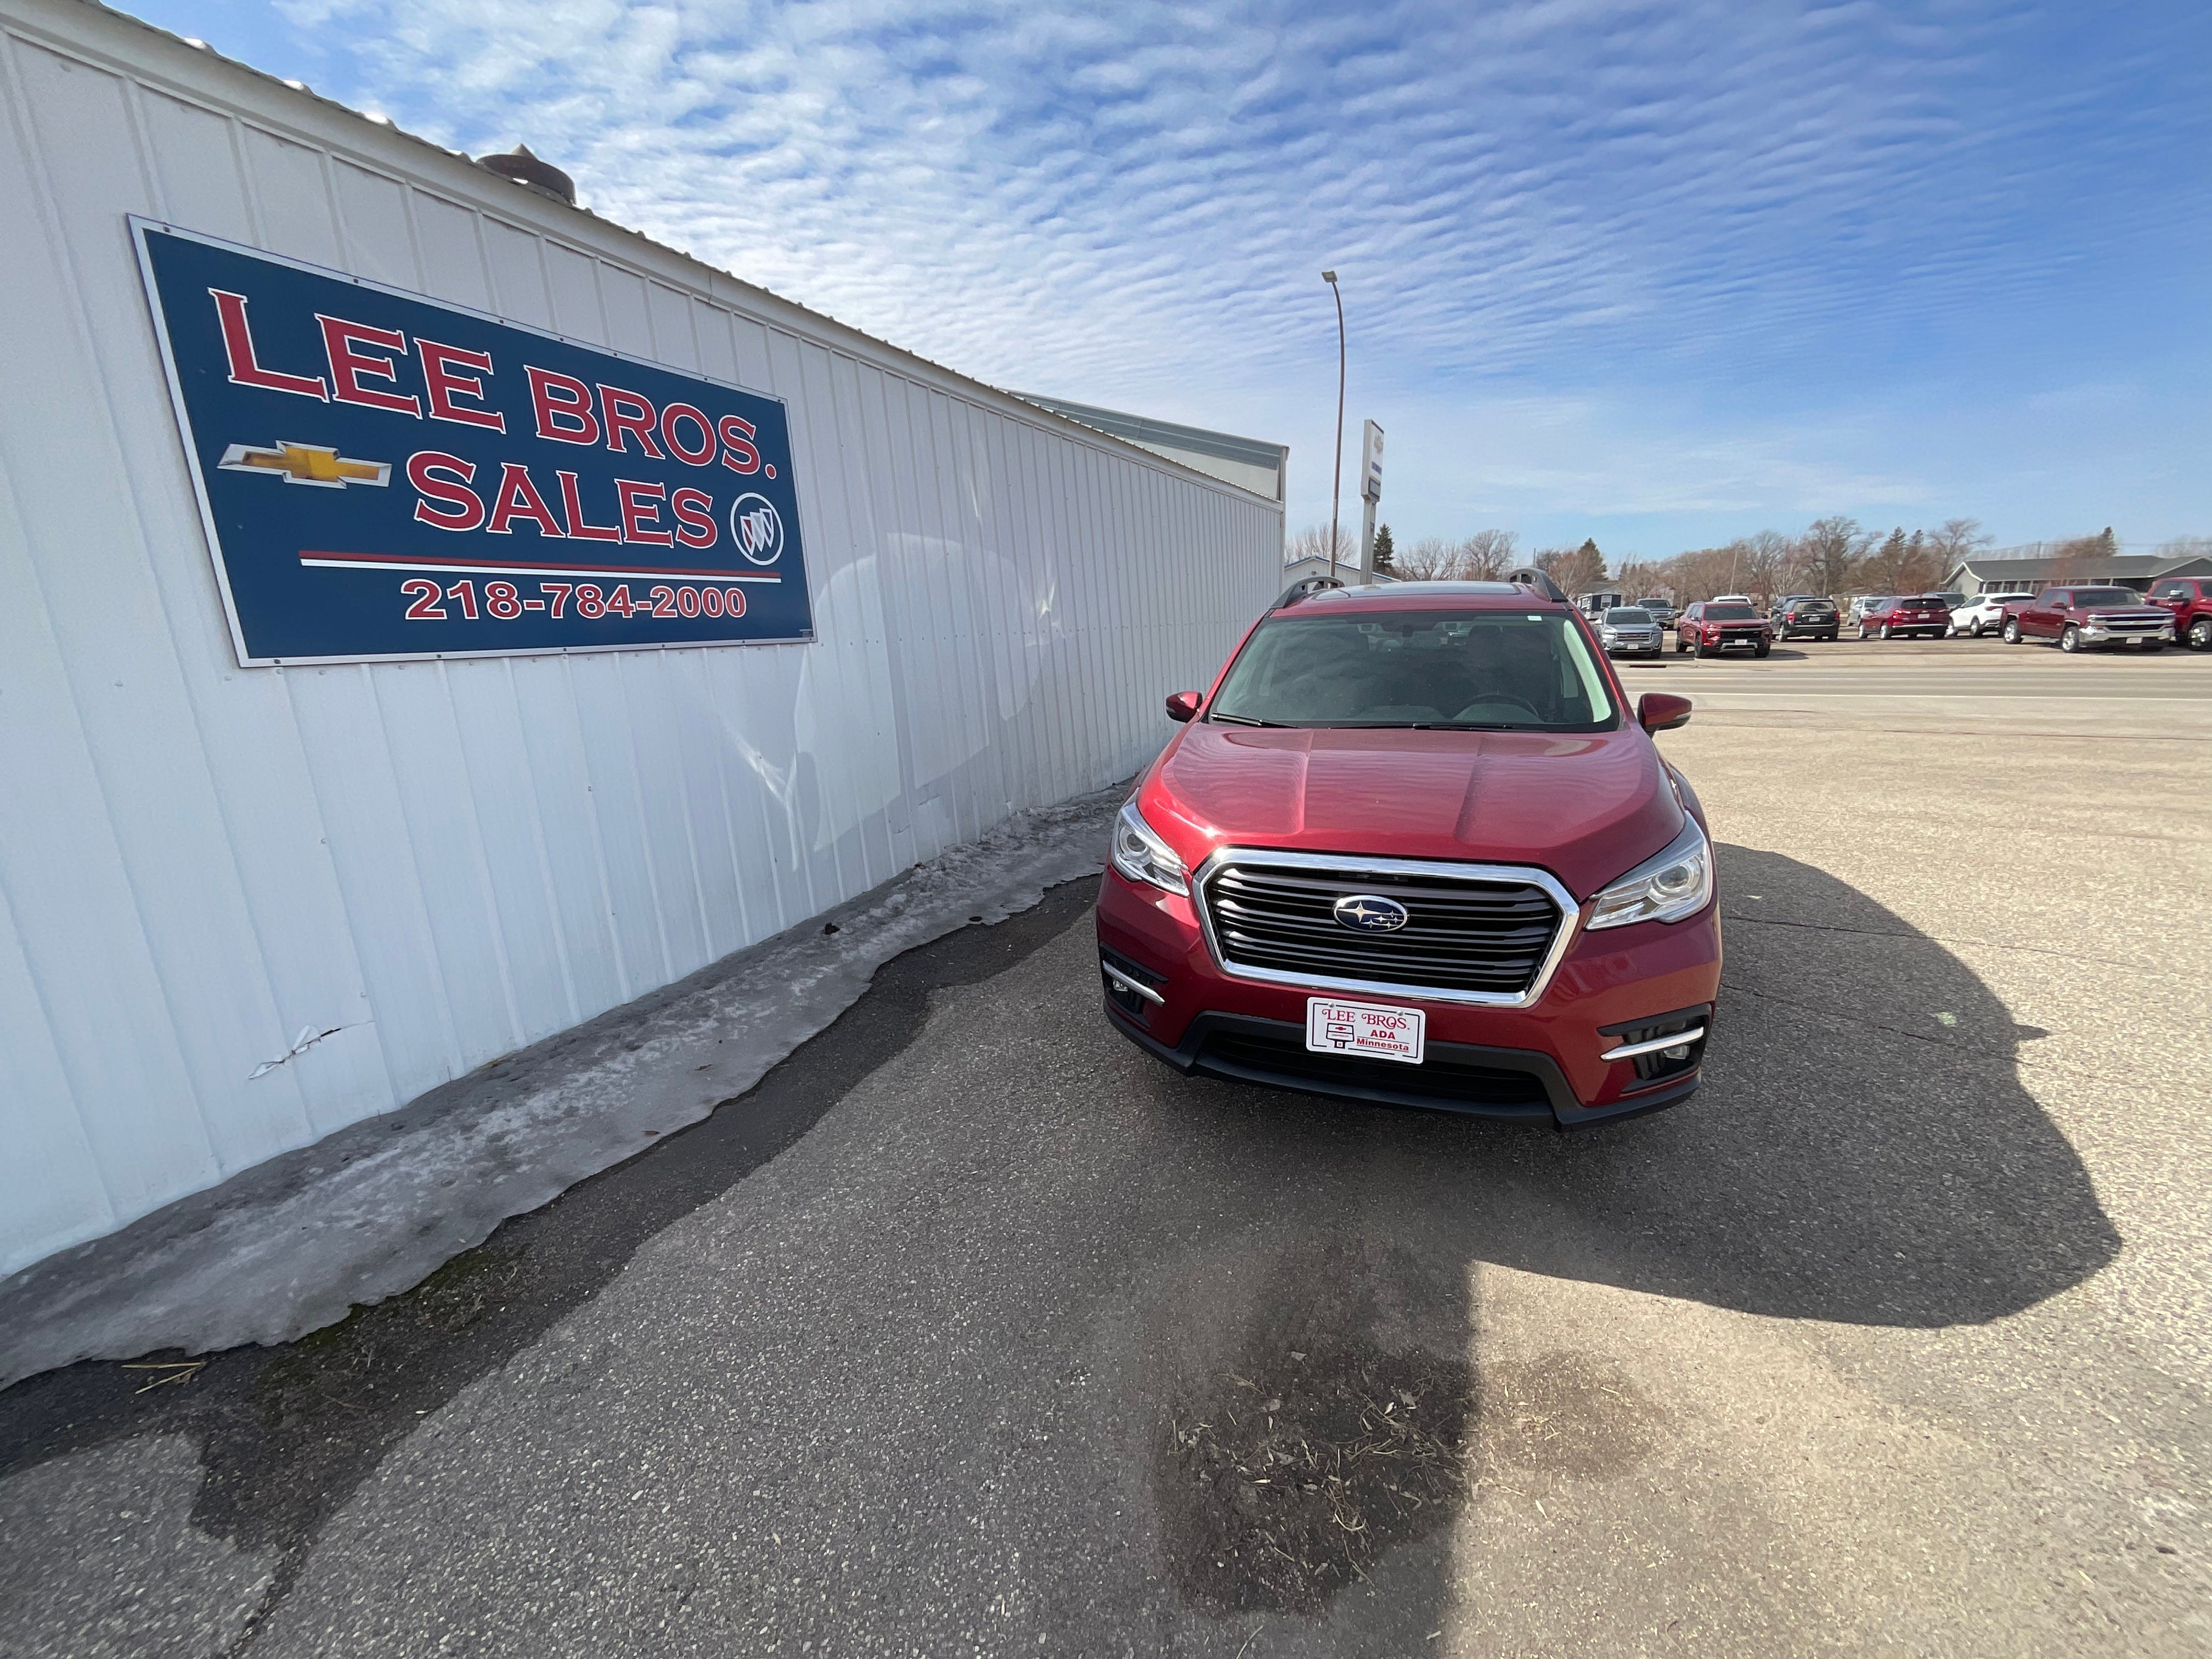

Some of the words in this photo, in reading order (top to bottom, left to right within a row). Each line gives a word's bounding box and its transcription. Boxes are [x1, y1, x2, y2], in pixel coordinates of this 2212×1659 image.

[207, 287, 506, 435] LEE
[524, 364, 777, 479] BROS.
[406, 450, 719, 548] SALES
[400, 578, 747, 620] 218-784-2000
[1322, 1008, 1356, 1023] LEE
[1361, 1013, 1410, 1030] BROS.
[1370, 1029, 1396, 1040] ADA
[1357, 1037, 1409, 1051] Minnesota
